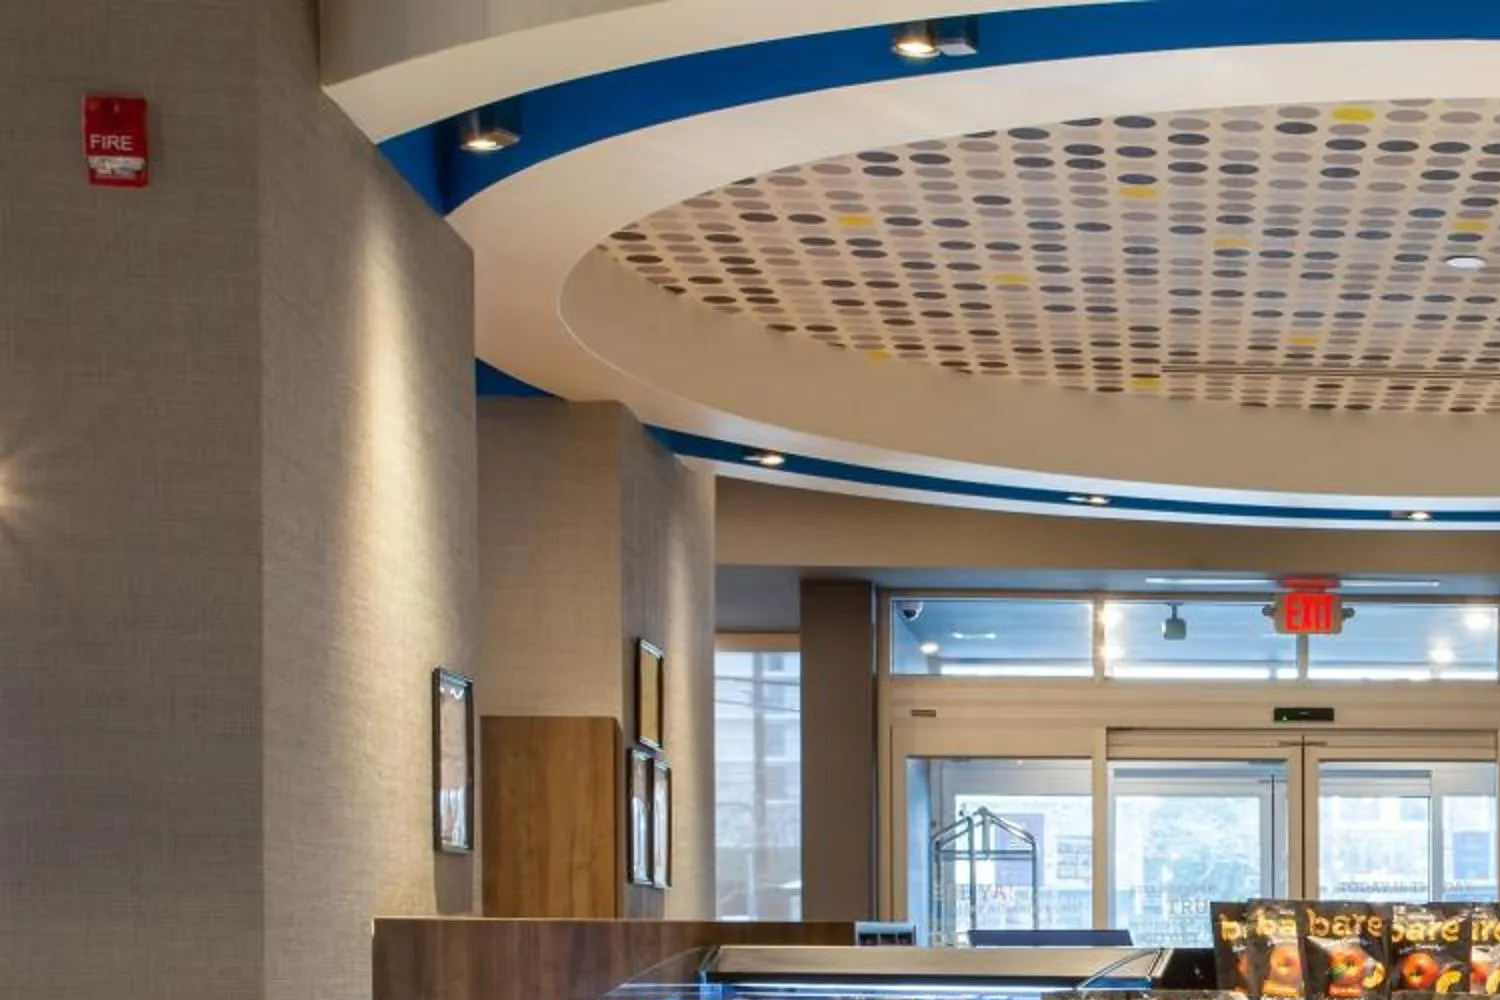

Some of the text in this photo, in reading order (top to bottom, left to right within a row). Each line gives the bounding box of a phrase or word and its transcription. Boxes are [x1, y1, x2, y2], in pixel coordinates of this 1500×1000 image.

[90, 133, 134, 151] FIRE
[1286, 594, 1332, 631] EXIT
[1305, 907, 1383, 937] bare
